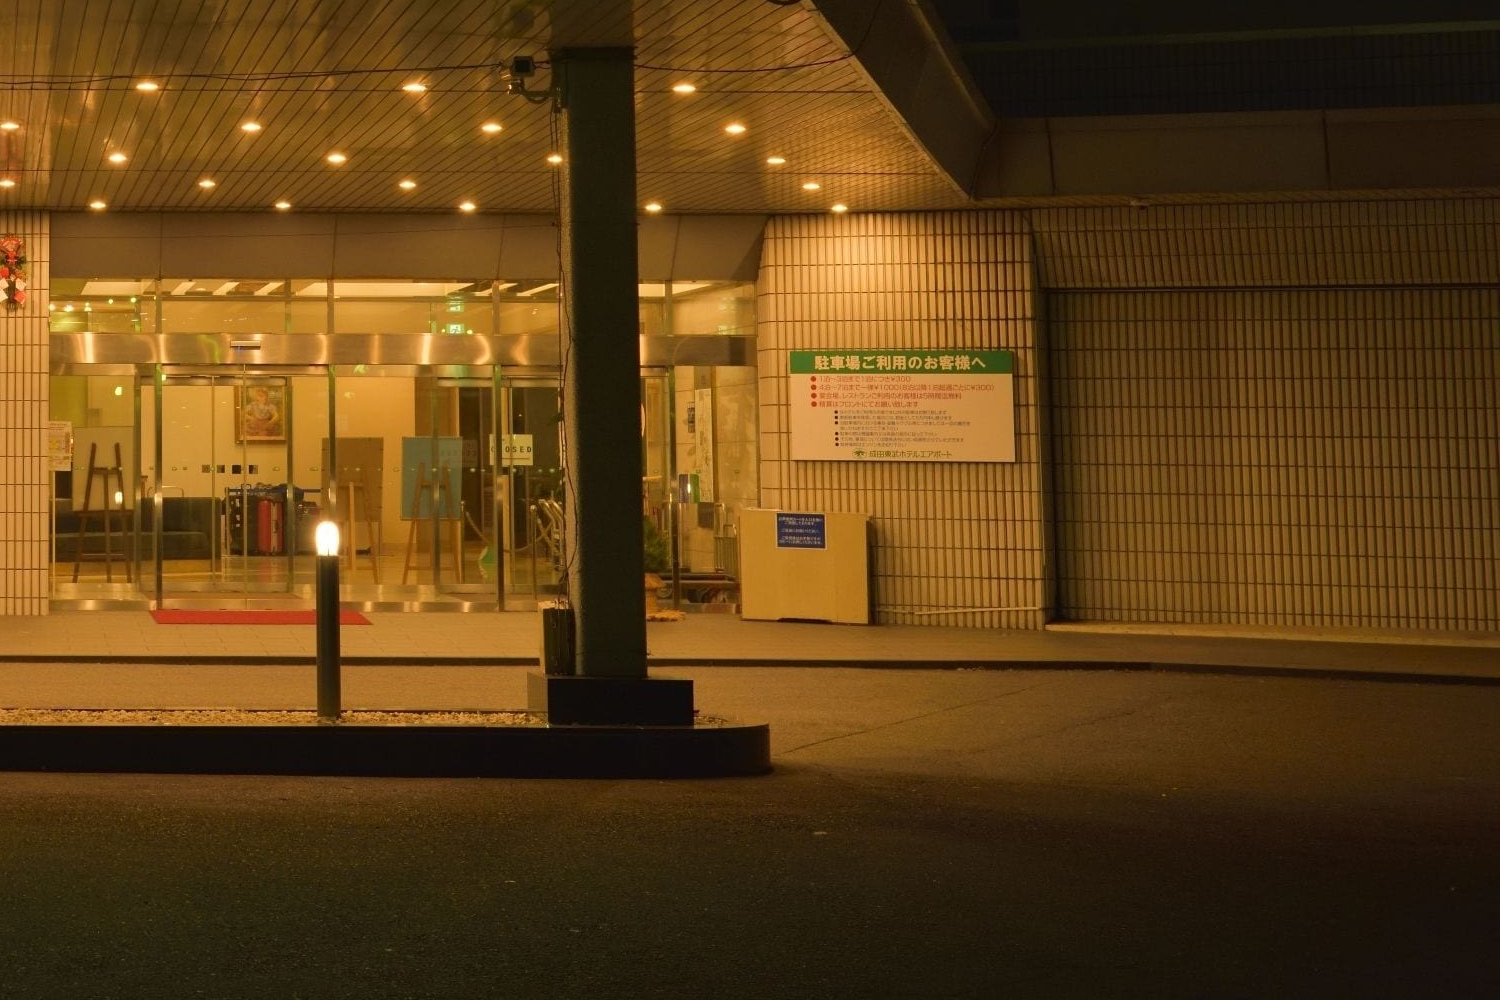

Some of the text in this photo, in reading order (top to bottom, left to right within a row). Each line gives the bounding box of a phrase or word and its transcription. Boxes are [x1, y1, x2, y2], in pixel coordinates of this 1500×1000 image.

[814, 355, 986, 371] 駐車場ご利用のお客様へ
